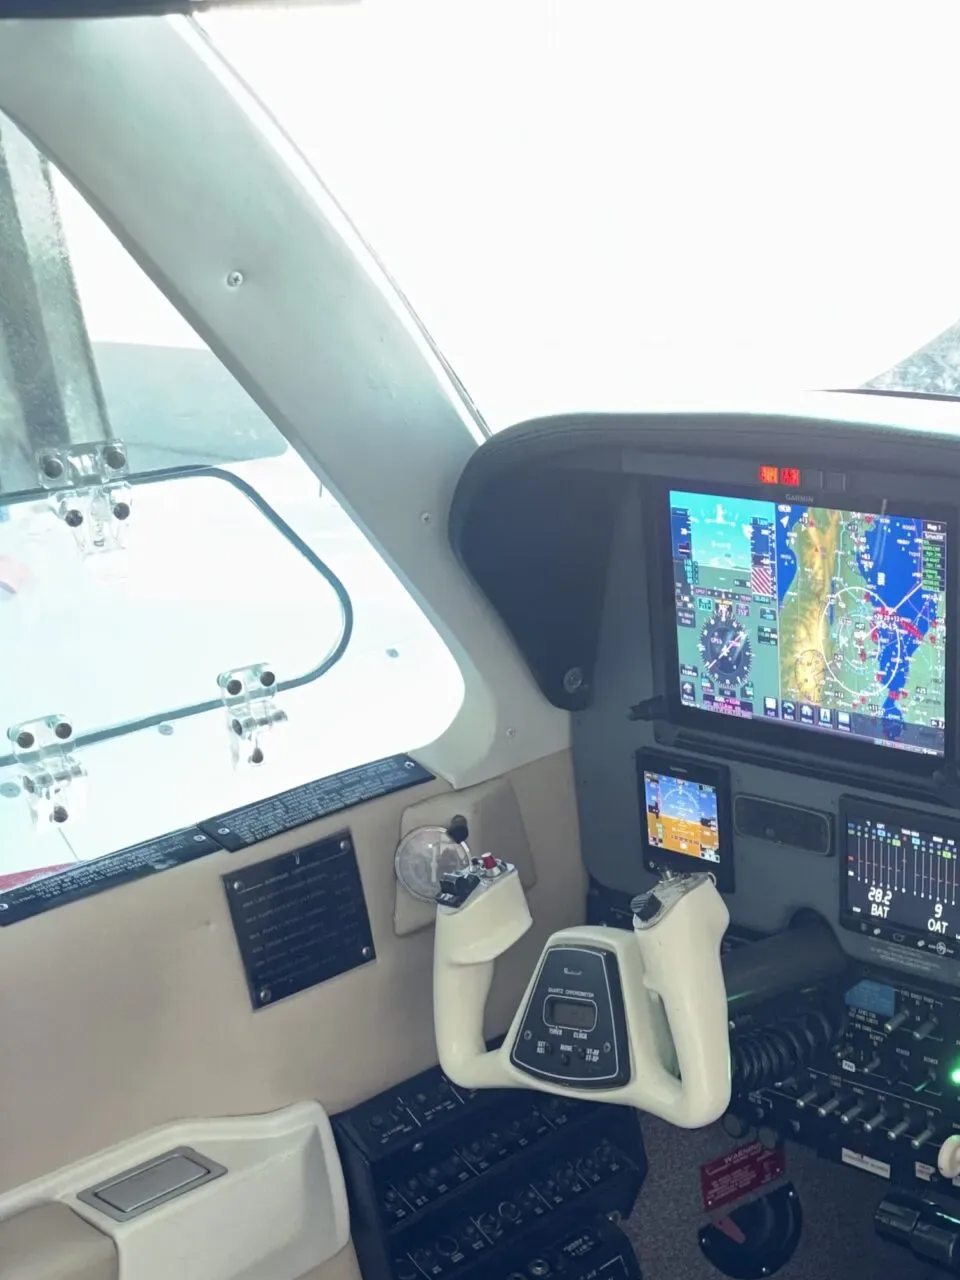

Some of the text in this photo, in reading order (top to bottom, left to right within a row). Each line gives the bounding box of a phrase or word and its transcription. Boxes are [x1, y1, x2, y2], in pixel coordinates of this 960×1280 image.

[785, 493, 814, 503] GARMIN
[868, 886, 892, 905] 28.2
[870, 903, 890, 919] BAT
[934, 903, 943, 918] 9
[928, 918, 949, 935] OAT
